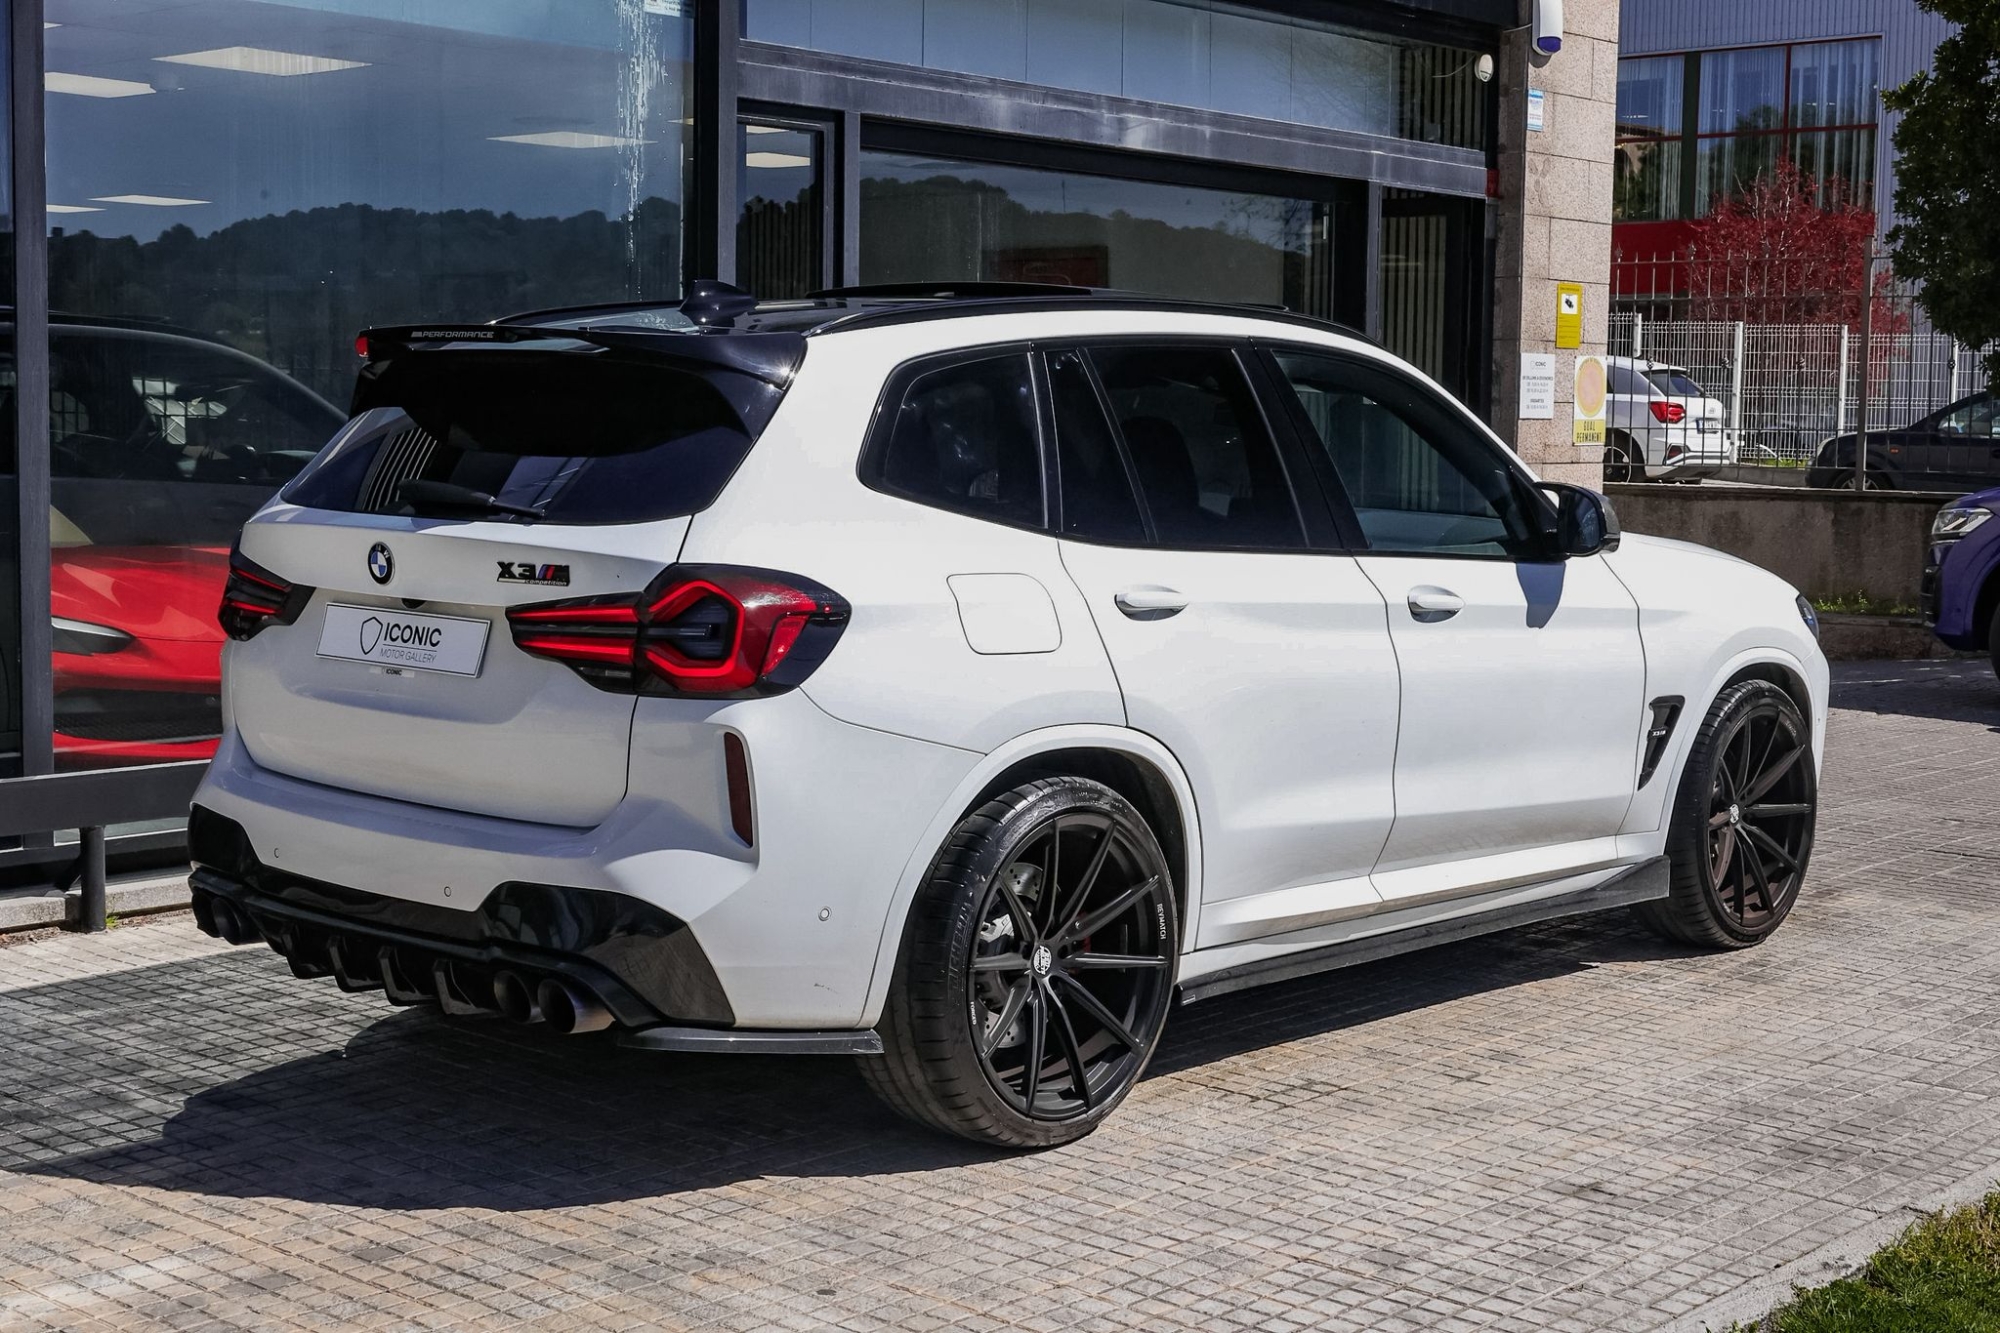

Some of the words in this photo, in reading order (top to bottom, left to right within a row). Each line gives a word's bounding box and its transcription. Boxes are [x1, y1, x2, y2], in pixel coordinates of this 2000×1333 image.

[383, 622, 442, 647] ICONIC
[379, 648, 405, 661] MOTOR
[405, 651, 437, 663] GALLERY
[386, 668, 402, 676] ICONIC
